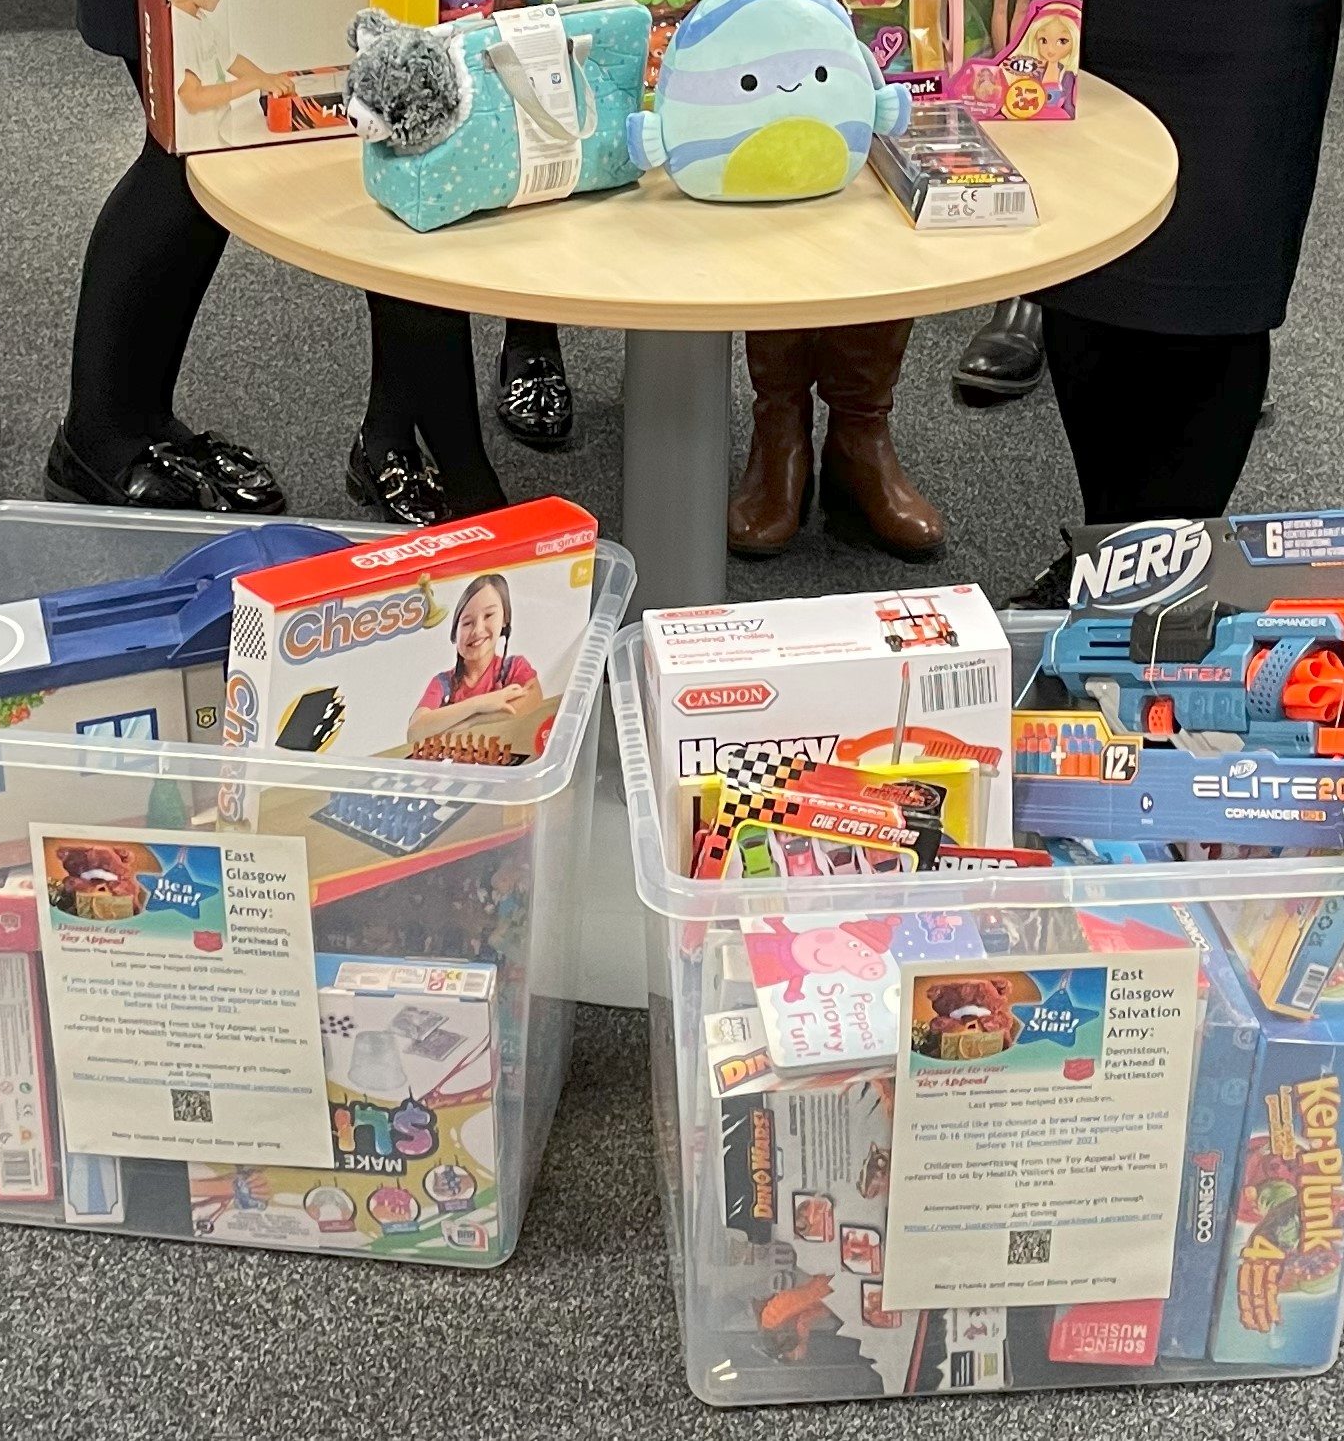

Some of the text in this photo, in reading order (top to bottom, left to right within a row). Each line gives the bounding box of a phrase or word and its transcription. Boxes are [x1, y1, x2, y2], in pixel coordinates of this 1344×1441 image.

[1266, 522, 1283, 557] 6
[1069, 520, 1205, 606] NERF
[282, 592, 426, 660] Chess
[661, 618, 764, 636] Henry
[1257, 617, 1326, 628] COMMANDER
[666, 632, 775, 646] Cleaning Trolley
[685, 684, 764, 708] CASDON
[1224, 807, 1300, 821] COMMANDER
[810, 813, 920, 845] DIE CAST CARS
[224, 850, 256, 863] East
[226, 867, 287, 884] Glasgow
[153, 892, 201, 907] Star!
[227, 886, 296, 902] Salvation
[229, 904, 274, 920] Army:
[231, 935, 279, 947] Parkhead
[1111, 969, 1144, 981] East
[1110, 988, 1174, 1002] Glasgow
[816, 982, 845, 1053] Snowy
[1033, 1008, 1055, 1022] Be
[1109, 1006, 1181, 1020] Salvation
[850, 991, 877, 1051] Peppa's
[1026, 1018, 1080, 1033] Star!
[787, 1011, 821, 1059] Fun!
[1107, 1026, 1155, 1041] Army:
[1104, 1057, 1155, 1068] Parkhead
[940, 1076, 989, 1087] Appeal
[968, 1101, 986, 1109] Last
[1049, 1116, 1077, 1124] brand
[344, 1154, 404, 1173] MAKE
[924, 1161, 963, 1170] Children
[1084, 1154, 1116, 1163] Appeal
[1070, 1165, 1096, 1173] Social
[1195, 1168, 1218, 1244] CONNECT
[1071, 1323, 1148, 1339] MUSEUM
[1073, 1337, 1146, 1354] SCIENCE
